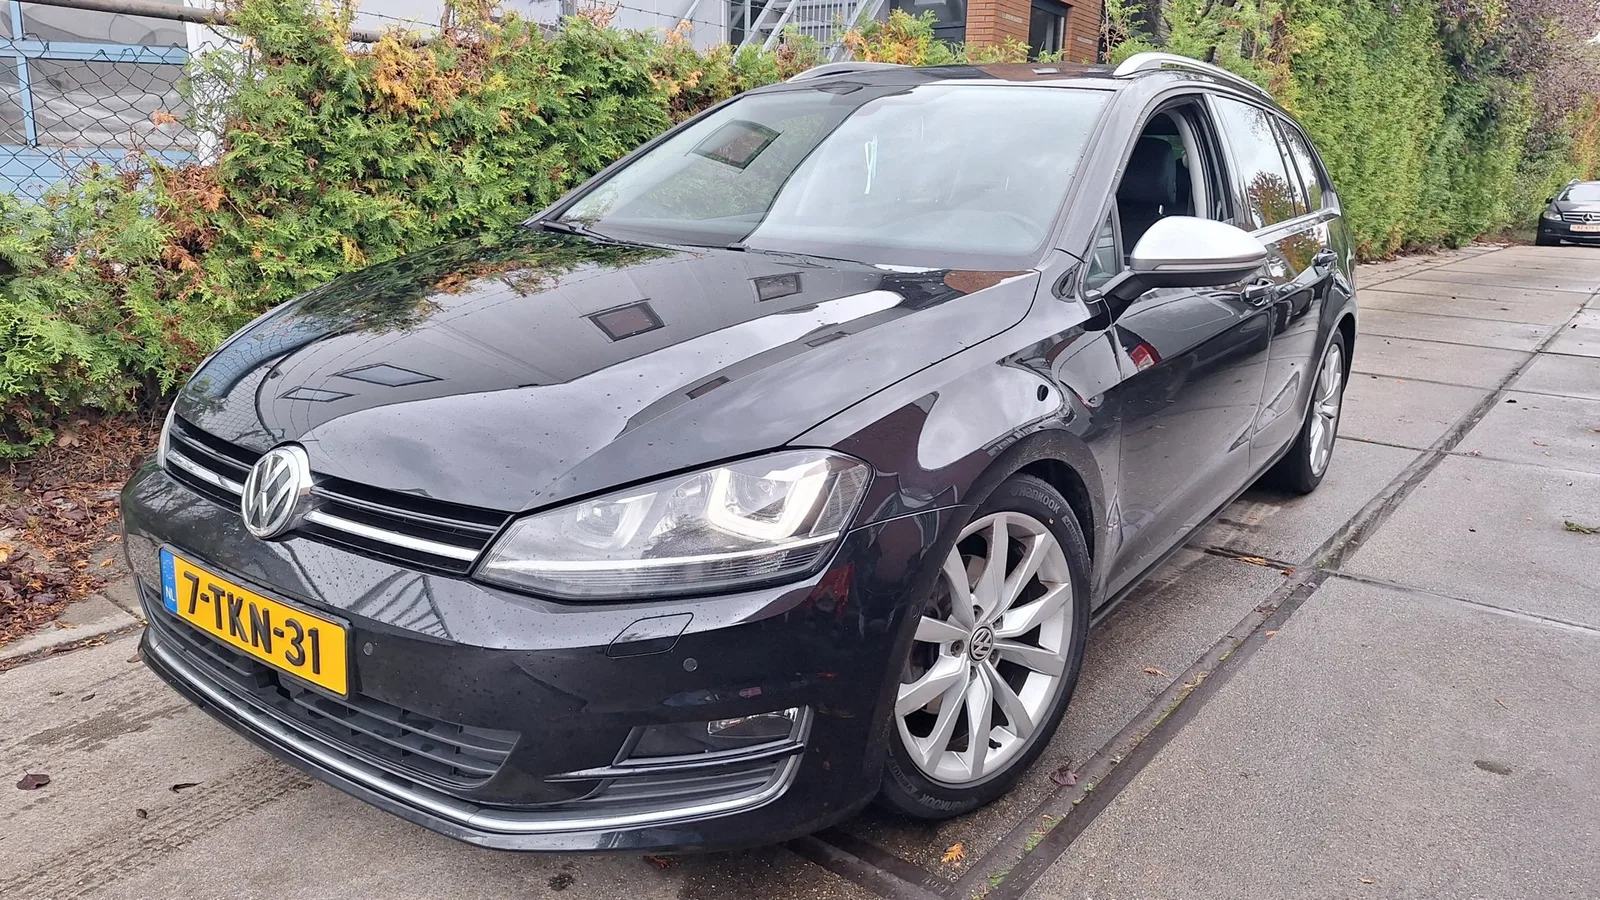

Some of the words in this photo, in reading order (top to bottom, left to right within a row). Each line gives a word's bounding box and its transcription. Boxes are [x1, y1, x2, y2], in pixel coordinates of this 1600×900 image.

[243, 449, 298, 536] VW
[164, 586, 176, 602] NL
[183, 570, 321, 675] 7-TKN-31
